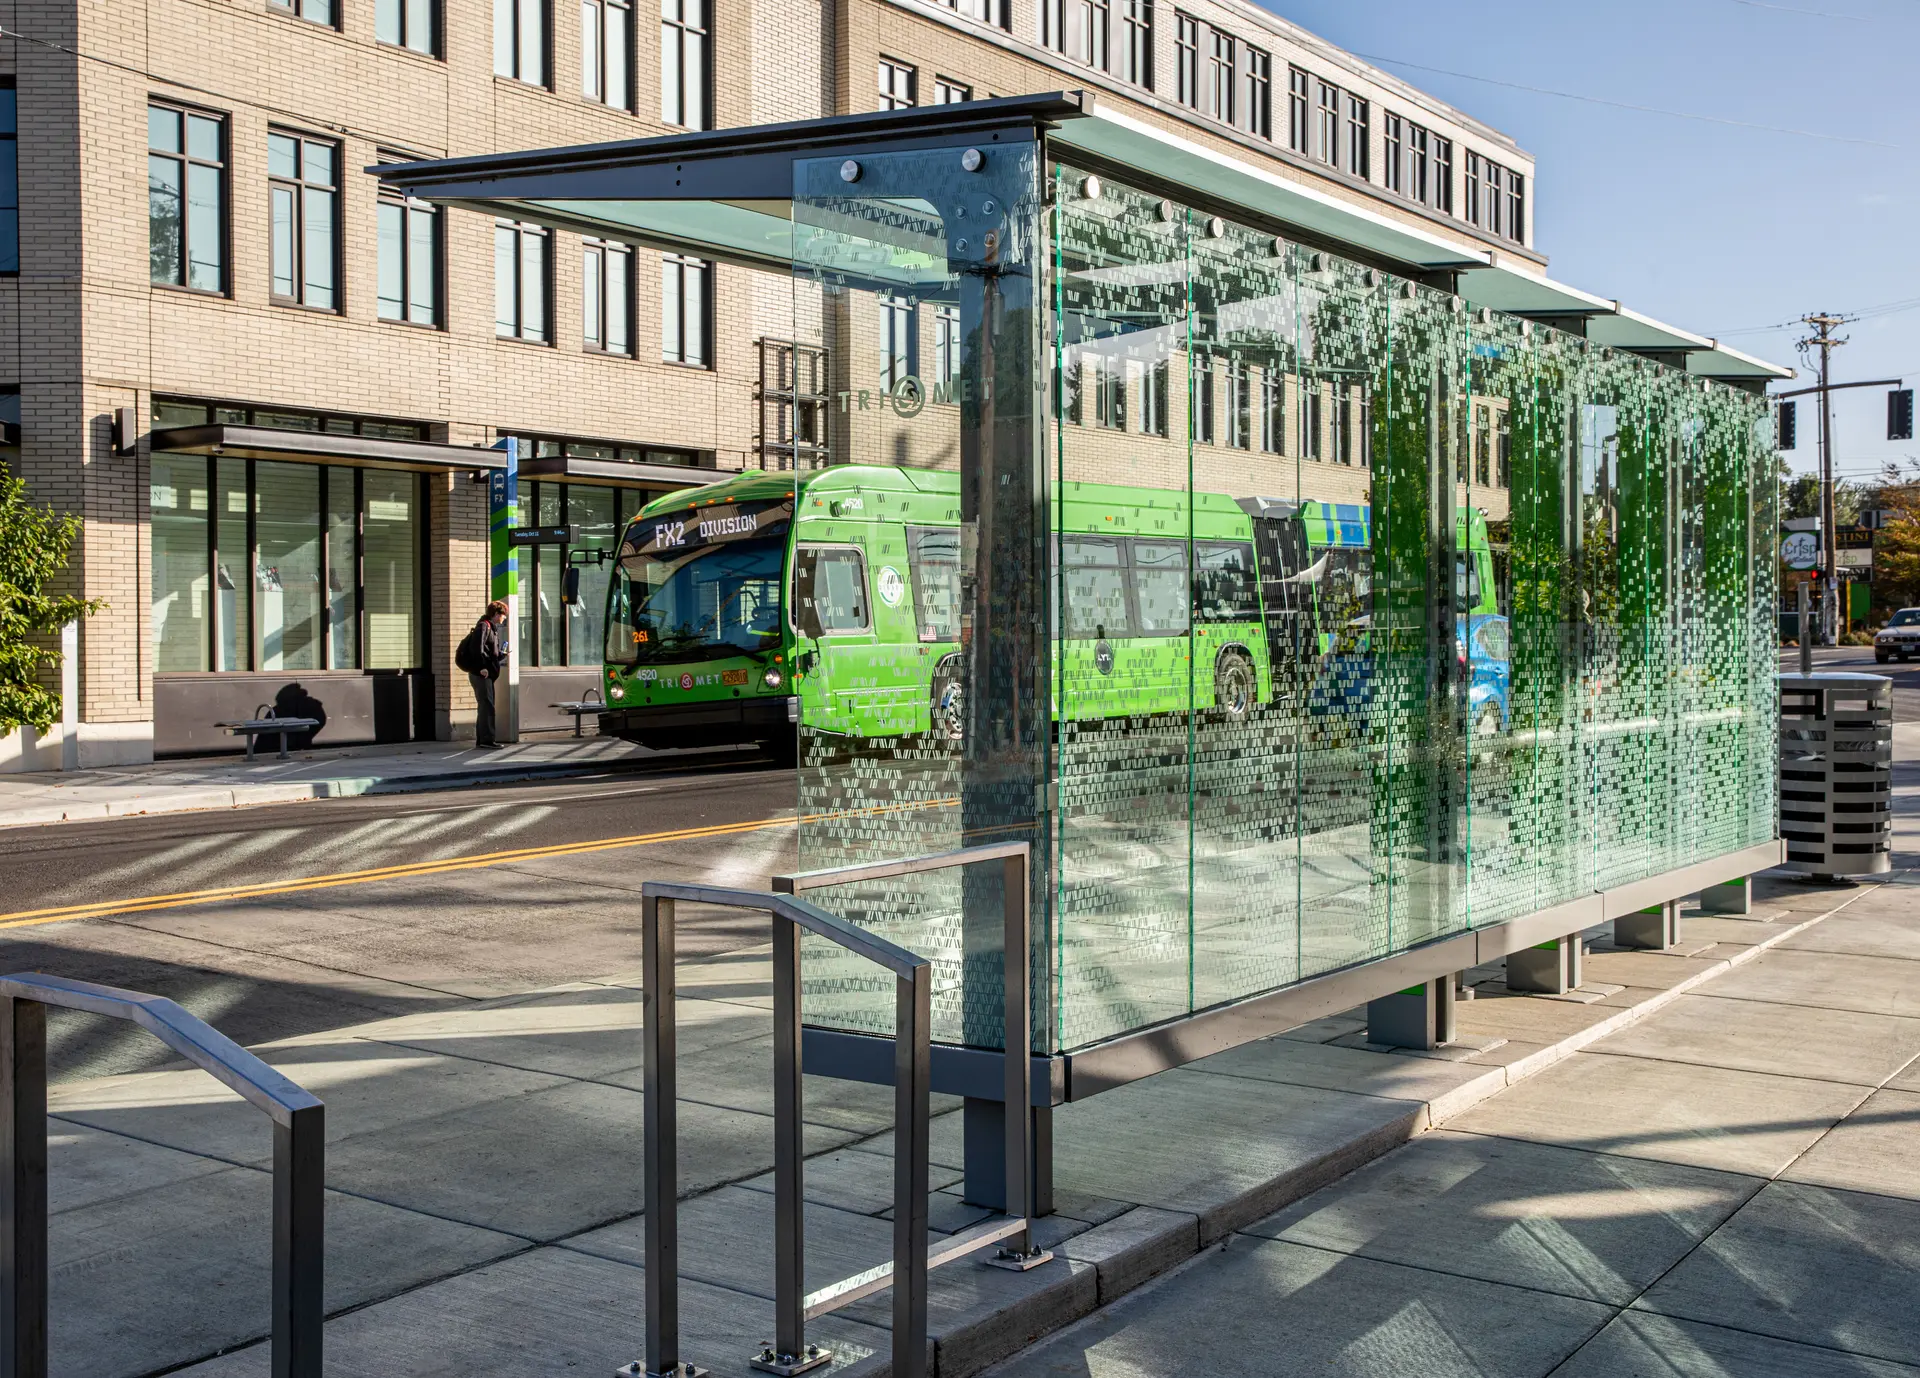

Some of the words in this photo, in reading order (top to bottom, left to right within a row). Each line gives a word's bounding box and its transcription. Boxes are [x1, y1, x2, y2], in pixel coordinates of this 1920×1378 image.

[839, 388, 885, 412] TRI
[494, 494, 504, 502] FX
[656, 522, 685, 548] FX2
[700, 514, 757, 538] DIVISION
[1784, 537, 1816, 557] Crisp
[632, 630, 648, 643] 261
[637, 669, 658, 681] 4520
[660, 678, 679, 689] TRI
[696, 674, 720, 687] MET
